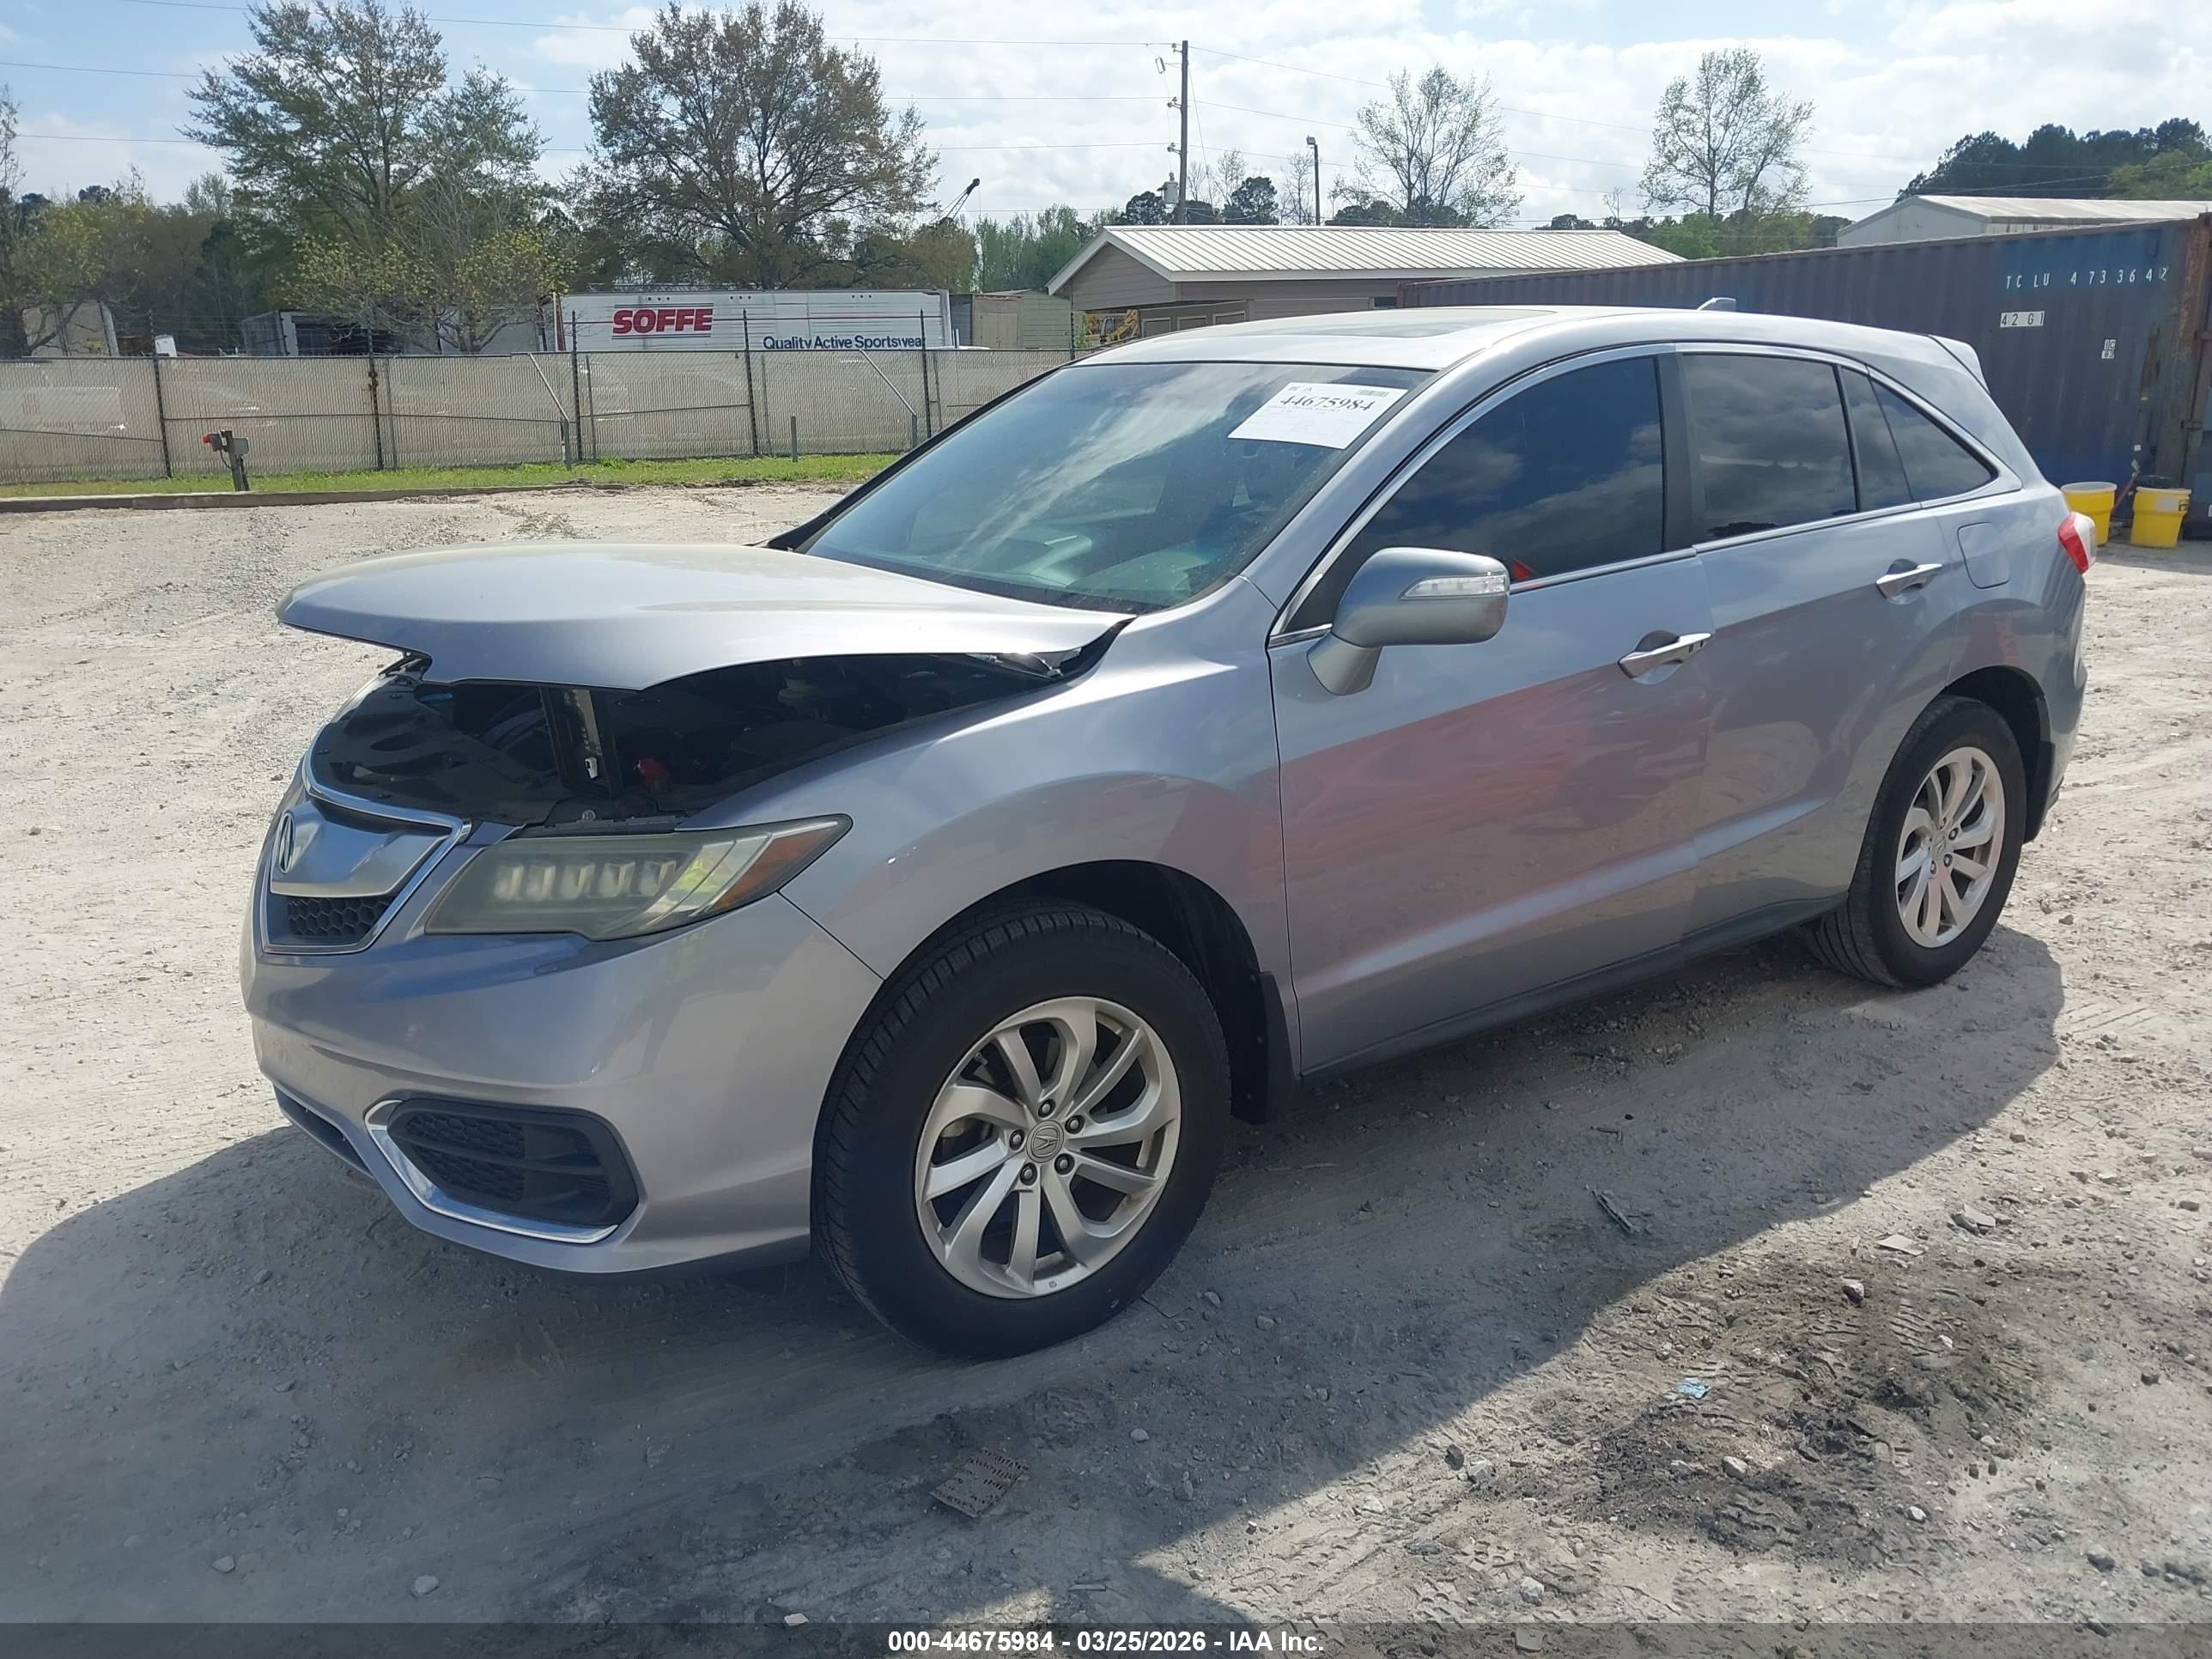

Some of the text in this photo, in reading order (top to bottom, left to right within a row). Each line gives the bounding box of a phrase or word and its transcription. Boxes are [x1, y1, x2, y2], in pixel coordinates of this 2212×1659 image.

[612, 308, 714, 334] SOFFE
[763, 336, 811, 349] Quality
[814, 336, 853, 349] Active
[1279, 395, 1376, 410] 44675984
